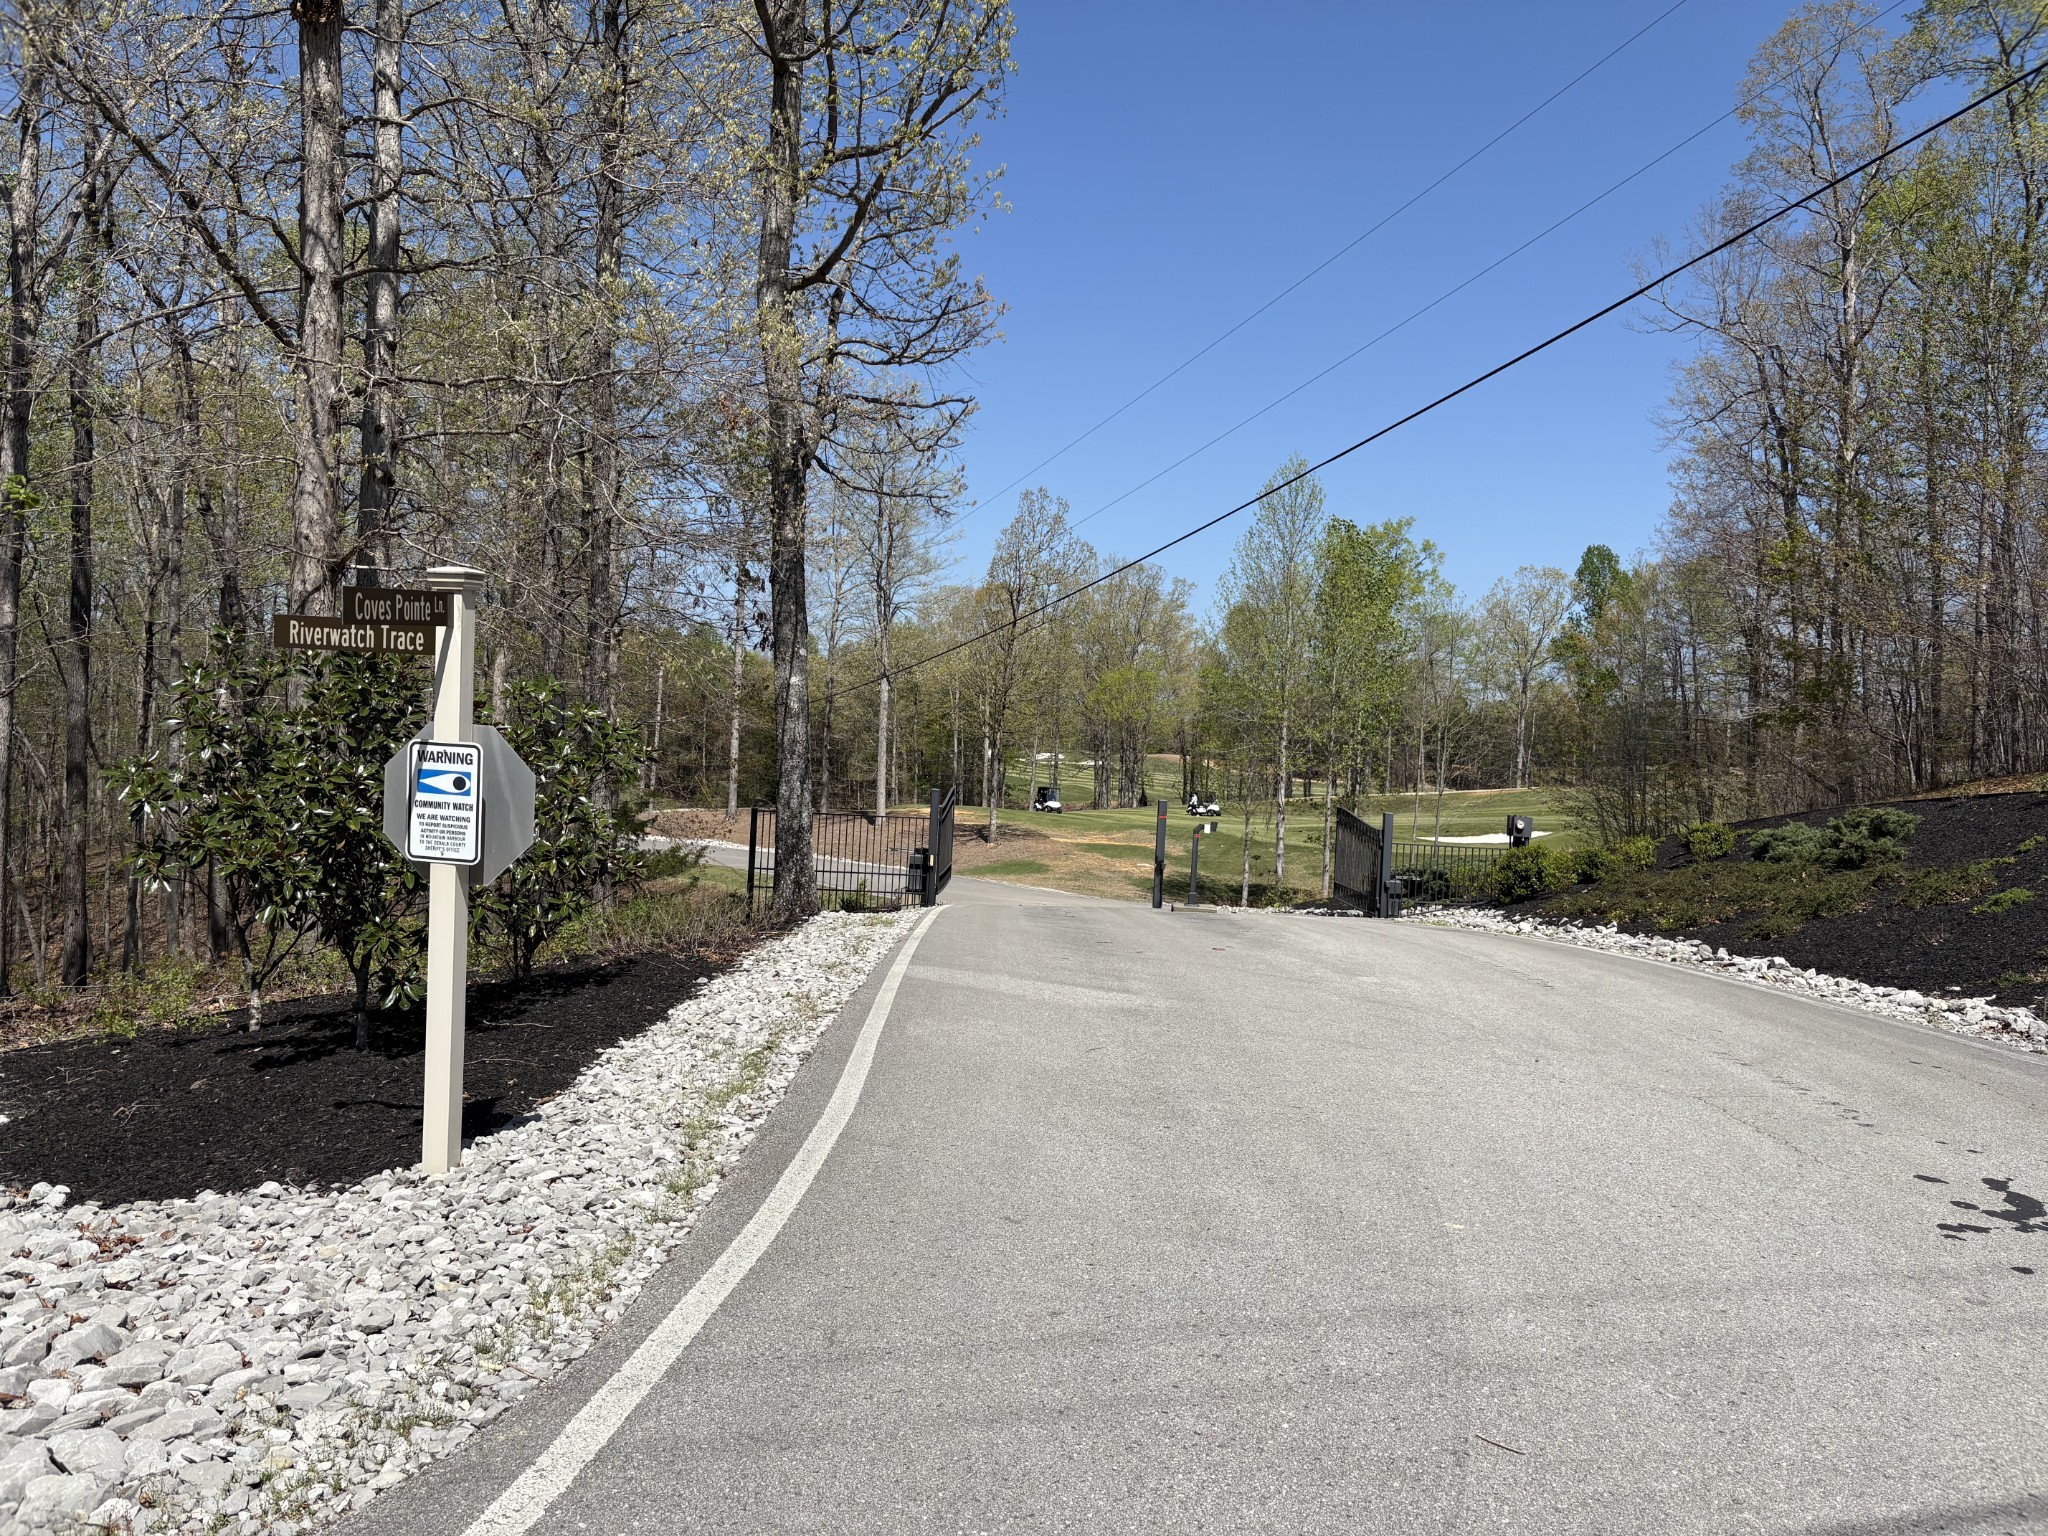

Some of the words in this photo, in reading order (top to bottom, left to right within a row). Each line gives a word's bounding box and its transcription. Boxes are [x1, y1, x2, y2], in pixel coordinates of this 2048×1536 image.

[355, 592, 392, 621] Coves
[396, 594, 431, 621] Pointe
[434, 596, 445, 614] Ln.
[289, 620, 374, 648] Riverwatch
[381, 625, 424, 651] Trace
[417, 750, 474, 766] WARNING
[414, 800, 450, 810] COMMUNITY
[452, 802, 474, 812] WATCH
[440, 815, 470, 823] WATCHING
